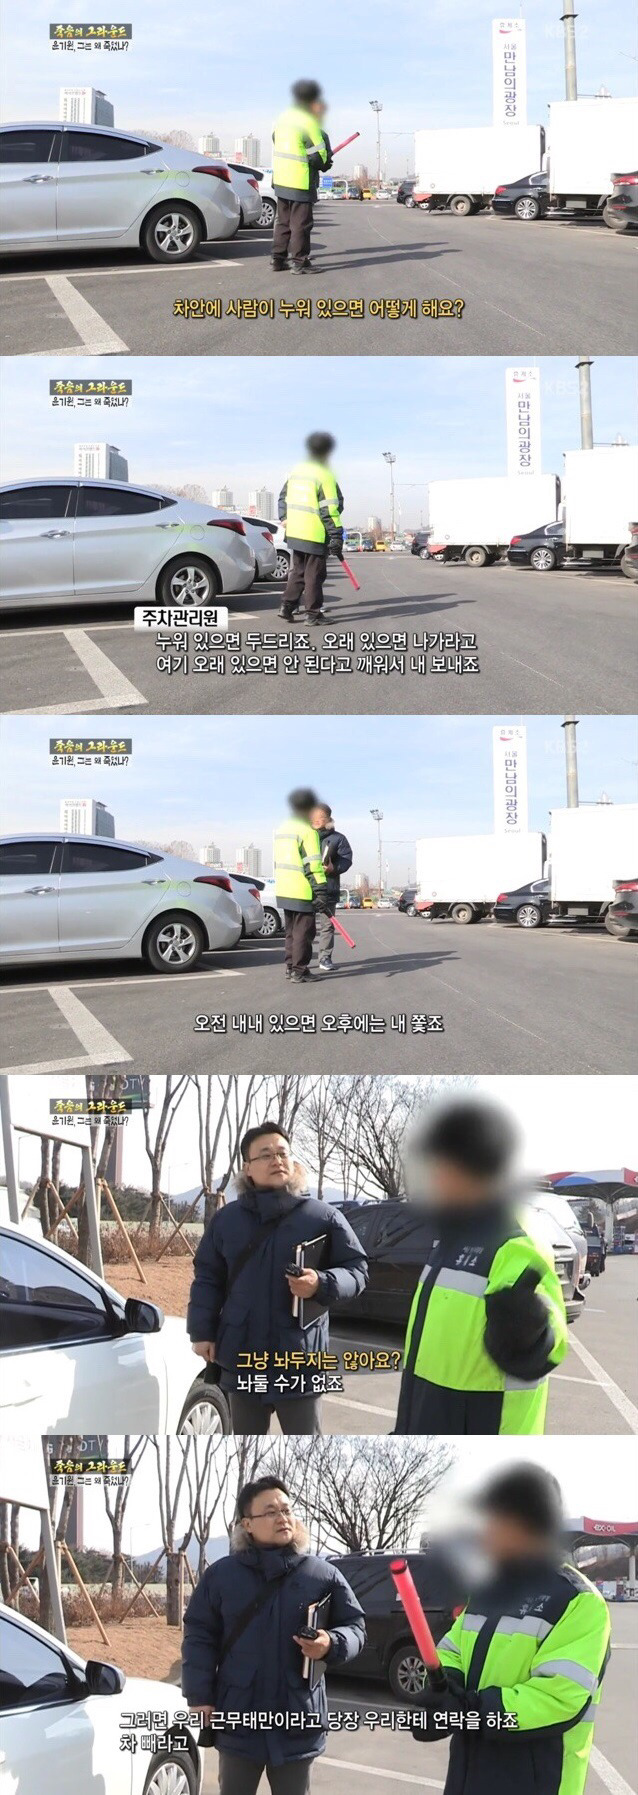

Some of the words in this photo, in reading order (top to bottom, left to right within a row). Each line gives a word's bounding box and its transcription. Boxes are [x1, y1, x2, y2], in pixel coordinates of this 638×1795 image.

[504, 51, 517, 117] 만남의광장
[518, 401, 532, 468] 만남의광장
[504, 759, 518, 826] 만남의광장
